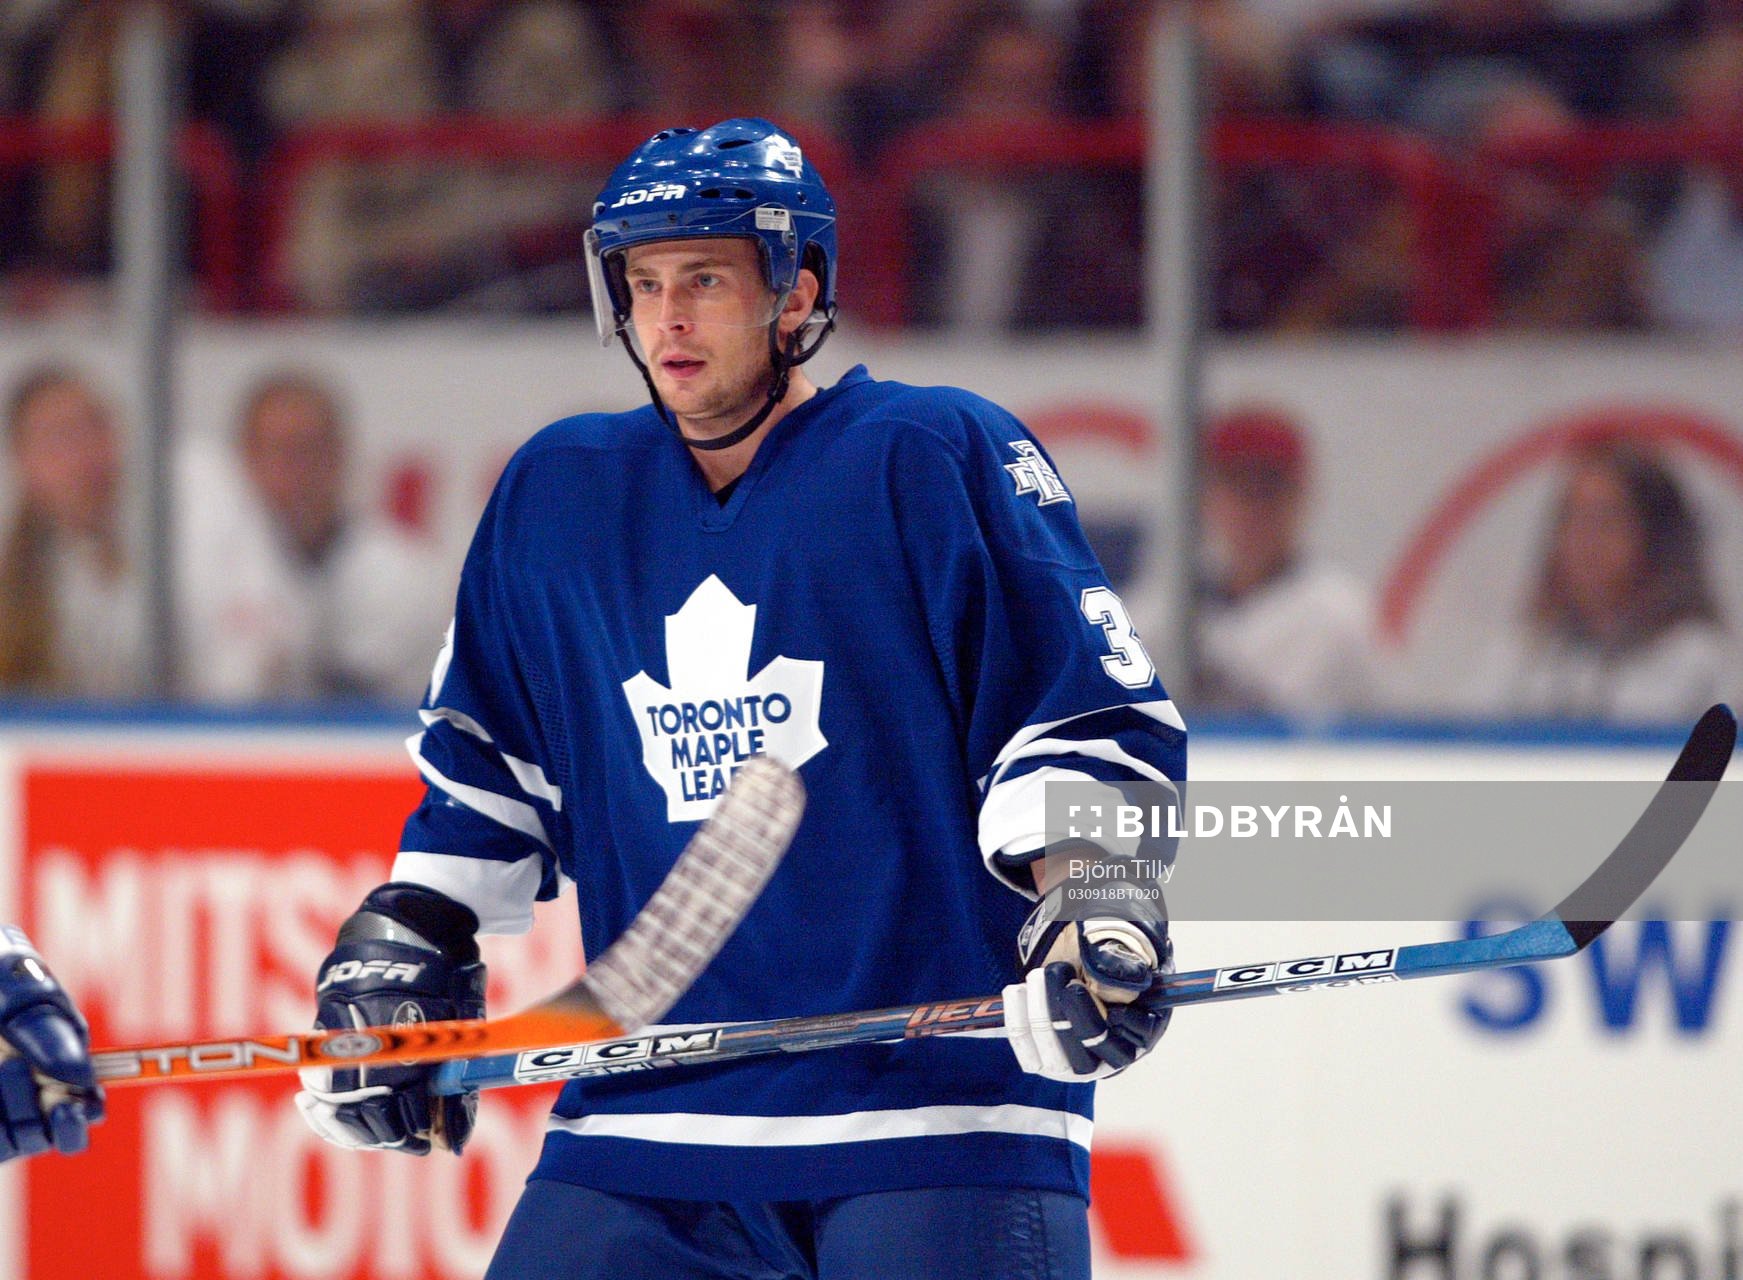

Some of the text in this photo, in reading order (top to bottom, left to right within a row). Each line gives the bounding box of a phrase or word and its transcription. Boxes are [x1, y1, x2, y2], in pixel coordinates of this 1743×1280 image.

[611, 184, 688, 208] JOFA
[647, 693, 792, 736] TORONTO
[671, 729, 765, 769] MAPLE
[317, 960, 422, 993] JOFA
[1227, 951, 1391, 983] CCM
[531, 1031, 713, 1067] CCM
